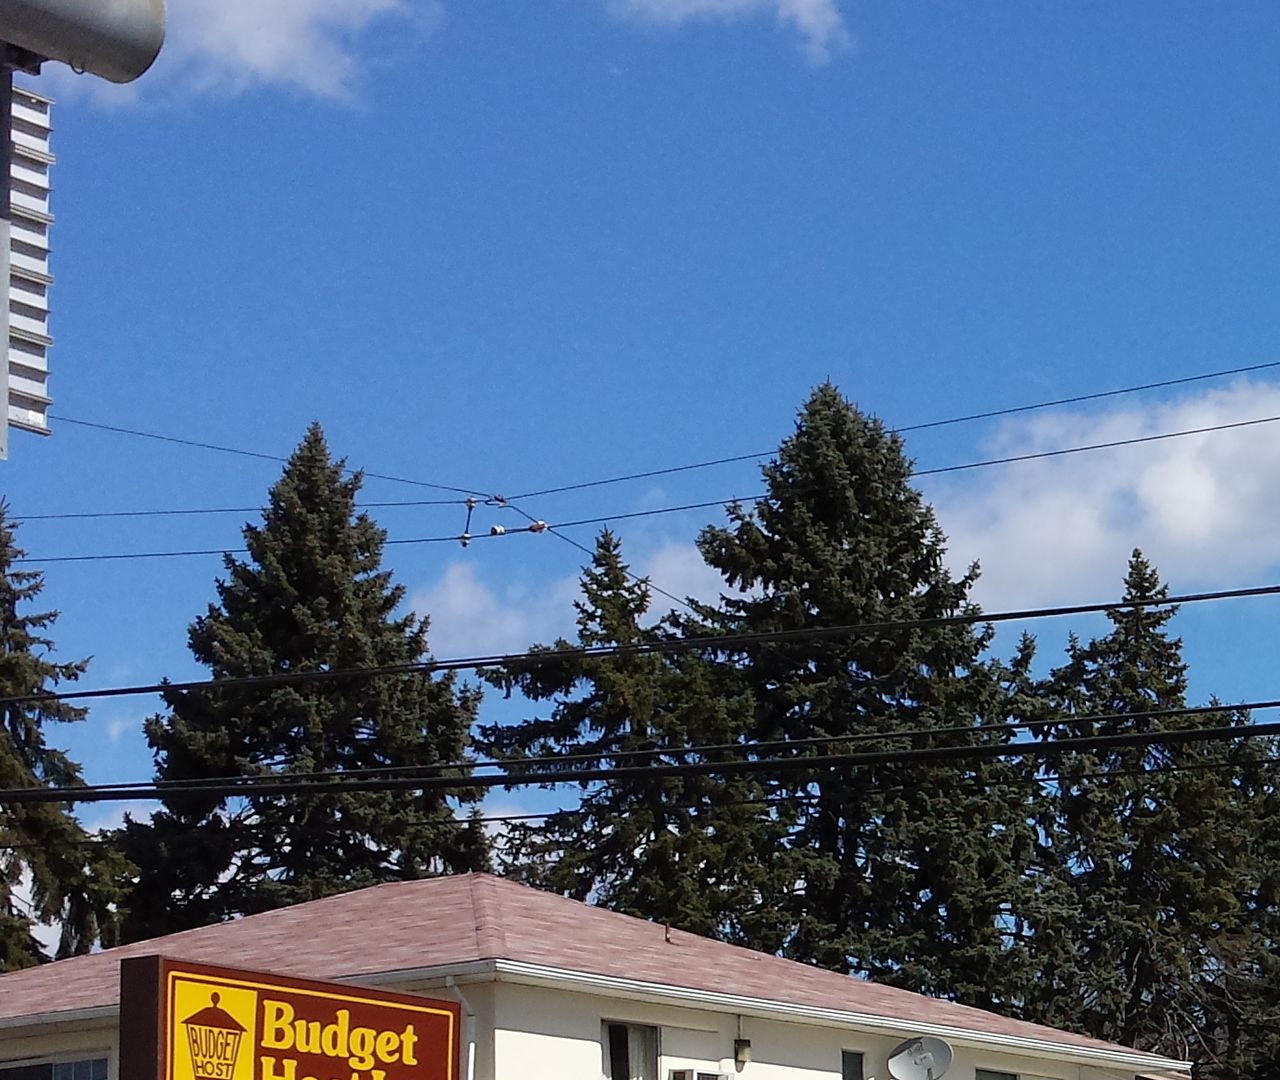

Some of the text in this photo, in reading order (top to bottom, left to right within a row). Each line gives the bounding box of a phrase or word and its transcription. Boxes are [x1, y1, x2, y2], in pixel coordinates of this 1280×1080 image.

[190, 1027, 241, 1061] BUDGET
[261, 1000, 418, 1070] Budget
[195, 1060, 233, 1077] HOST
